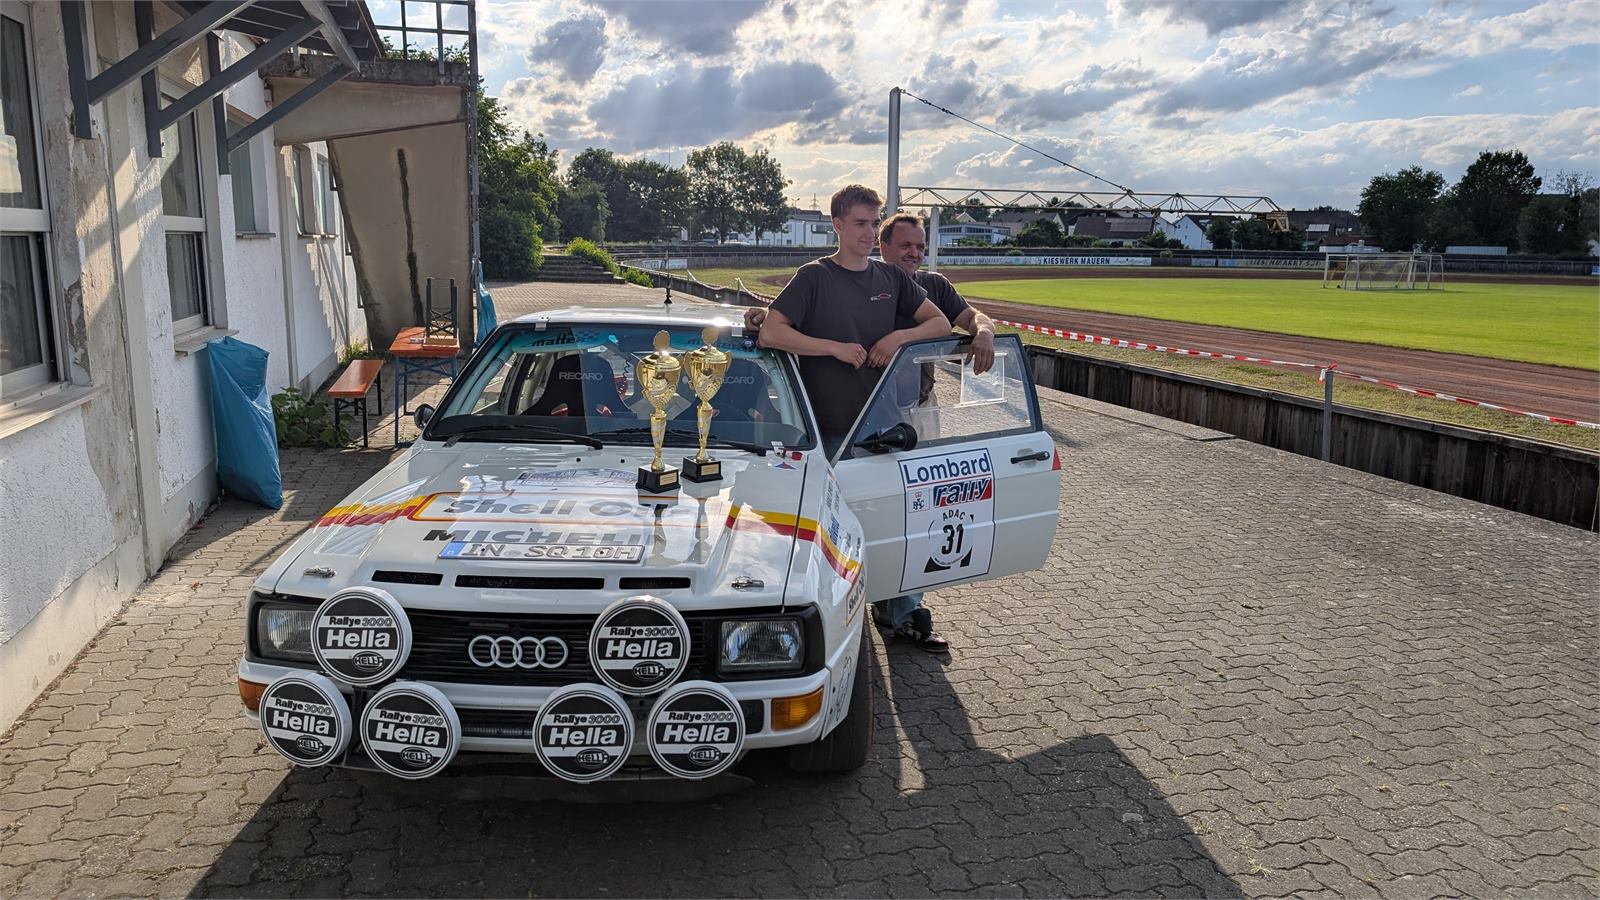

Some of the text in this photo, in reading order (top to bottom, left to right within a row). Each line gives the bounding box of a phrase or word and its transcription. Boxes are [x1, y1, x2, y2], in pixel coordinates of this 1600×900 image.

[1043, 257, 1079, 265] KIESWERK
[1081, 257, 1110, 265] MAUERN
[558, 371, 604, 381] RECARO
[722, 375, 755, 385] ECARO
[903, 453, 991, 484] Lombard
[935, 478, 990, 507] rally
[443, 500, 578, 516] Shell
[942, 509, 966, 521] ADAC
[941, 523, 965, 554] 31
[461, 543, 637, 560] IN SQ 10H
[329, 616, 393, 627] Rallye 3000
[326, 629, 390, 647] Hella
[610, 627, 677, 637] Rallye 3000
[605, 639, 674, 658] Hella
[275, 698, 333, 716] Rallye 3000
[272, 709, 330, 735] Hella
[380, 710, 444, 726] Rallye 3000
[553, 715, 621, 725] Rallye 3000
[668, 712, 734, 722] Rallye 3000
[375, 722, 440, 746] Hella
[548, 727, 617, 745] Hella
[662, 724, 730, 743] Hella
